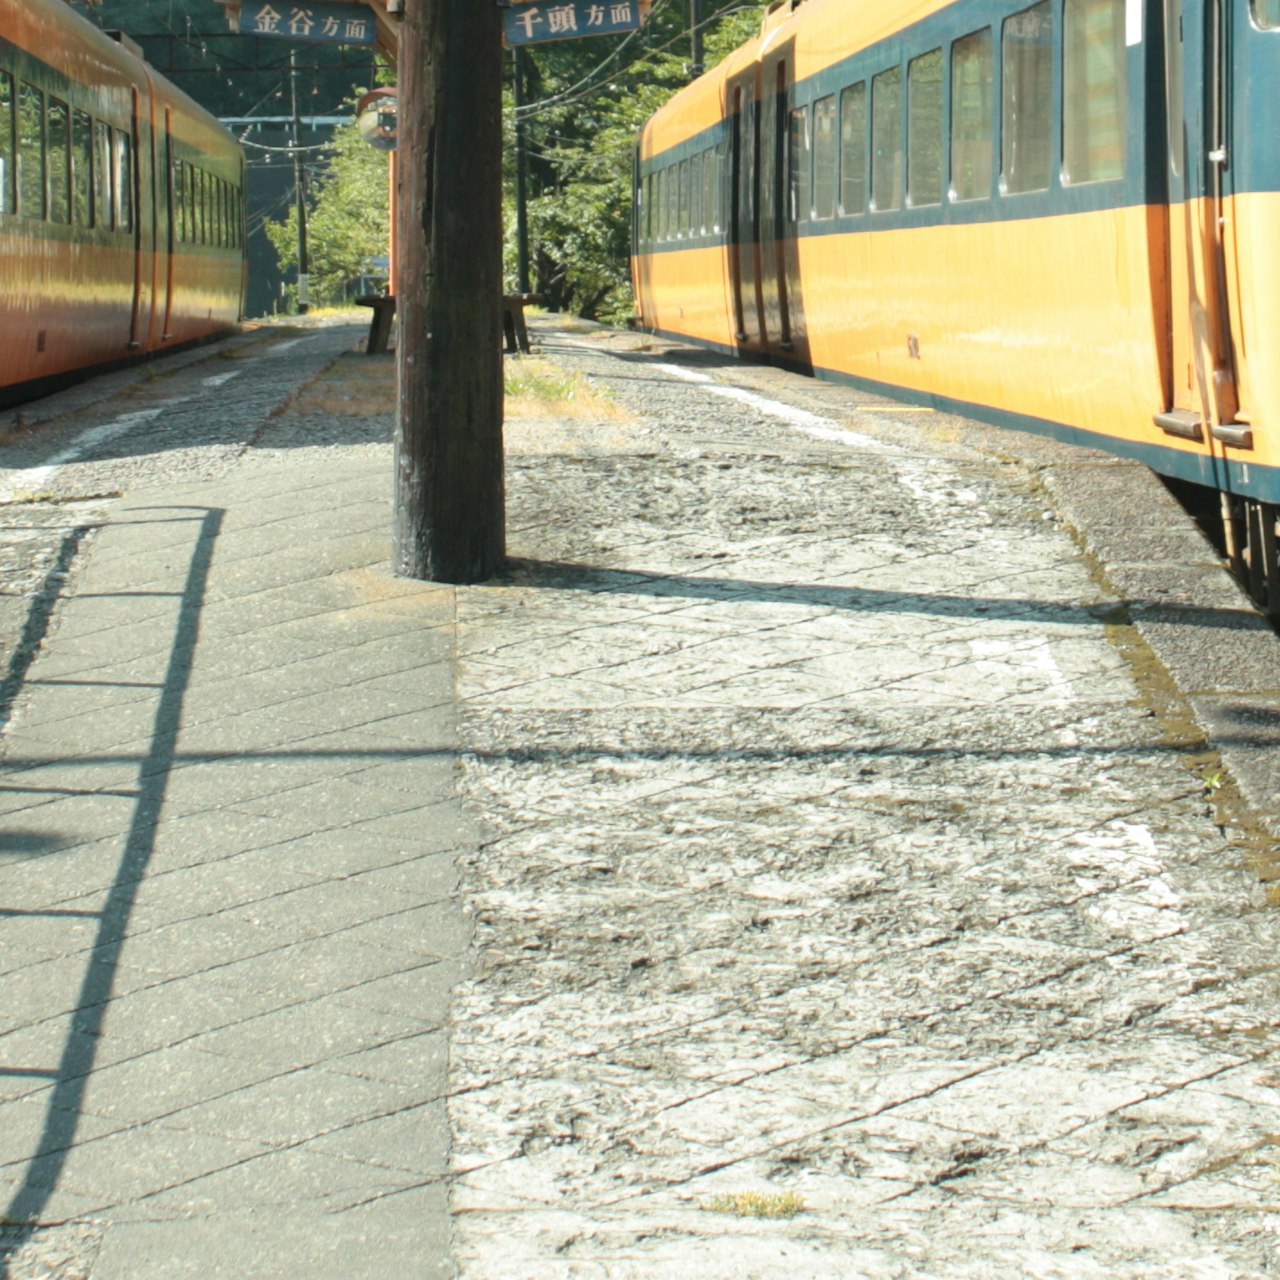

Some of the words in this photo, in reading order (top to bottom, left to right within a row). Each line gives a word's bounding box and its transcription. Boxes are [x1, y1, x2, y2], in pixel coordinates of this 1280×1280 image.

[253, 4, 366, 39] 金谷方面
[515, 2, 631, 38] 千頭方面
